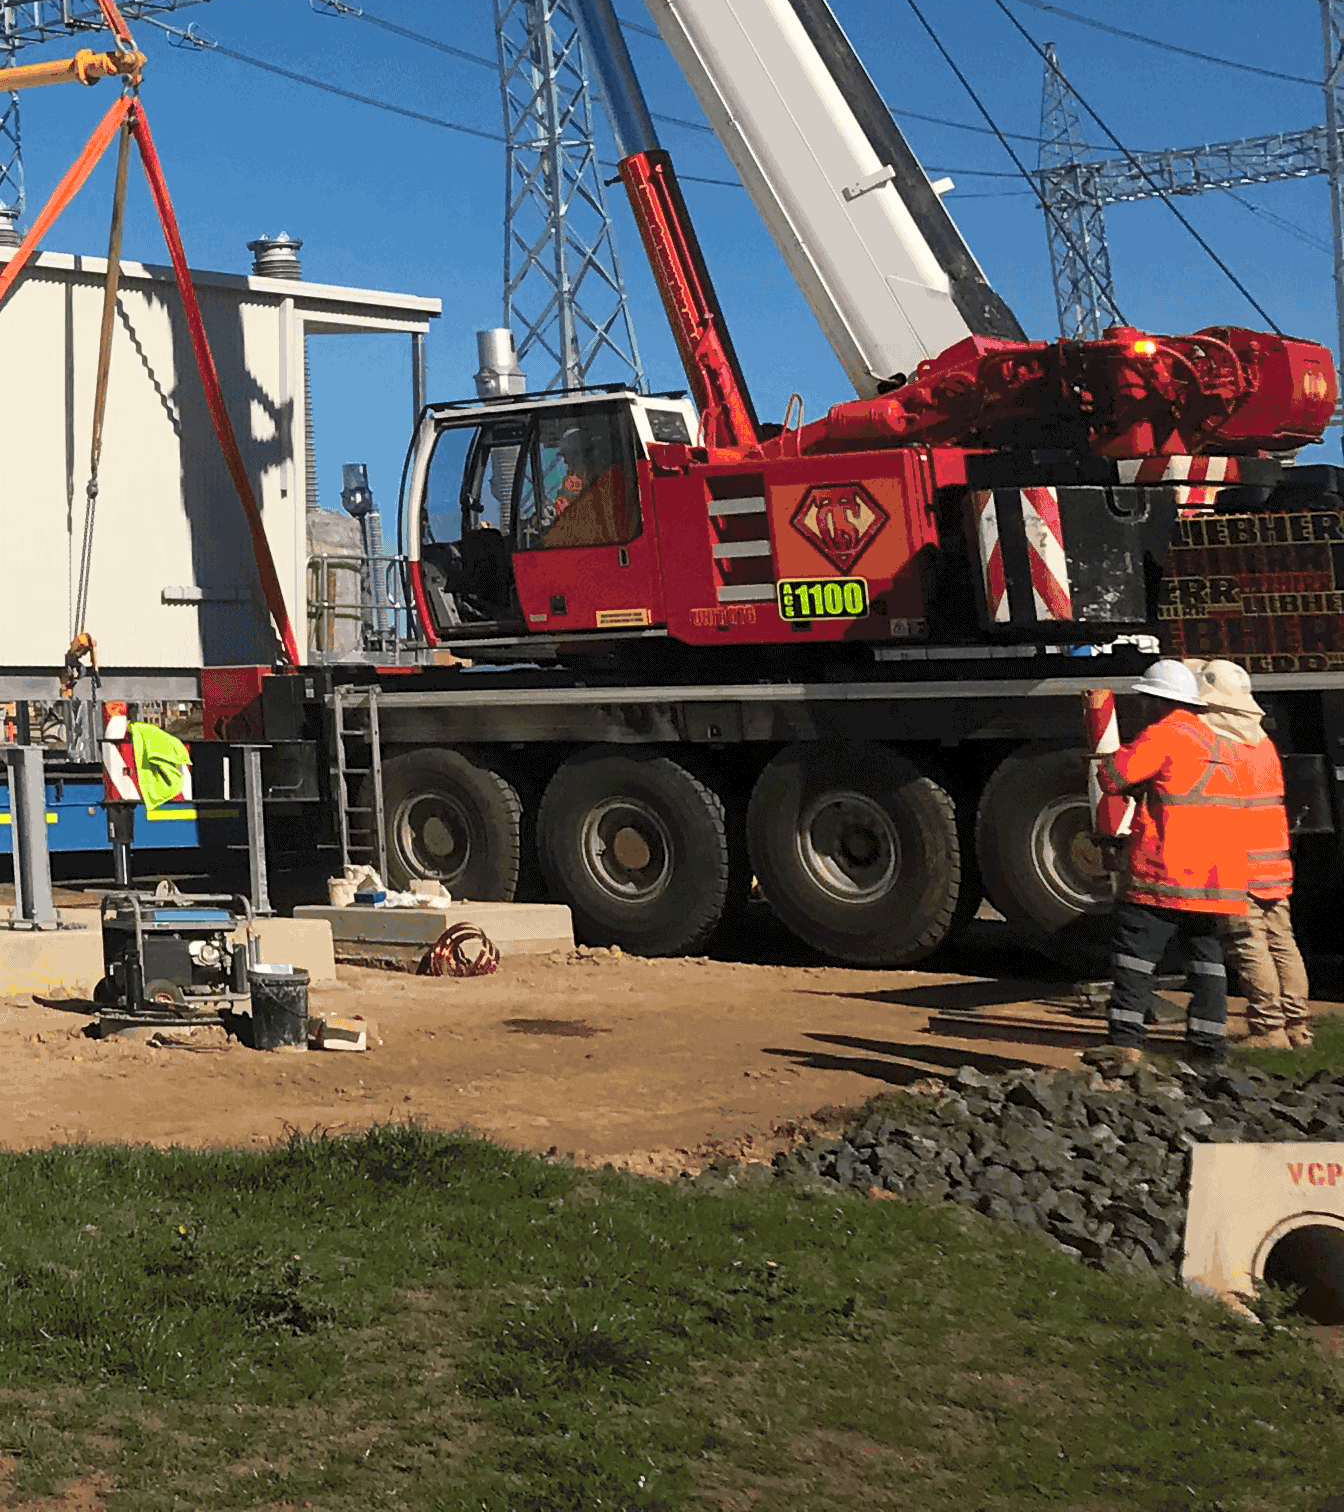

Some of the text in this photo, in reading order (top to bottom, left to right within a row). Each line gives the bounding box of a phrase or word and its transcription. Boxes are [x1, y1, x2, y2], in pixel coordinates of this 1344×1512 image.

[783, 583, 795, 617] ACS
[796, 582, 863, 615] 1100
[1286, 1162, 1343, 1187] VCP
